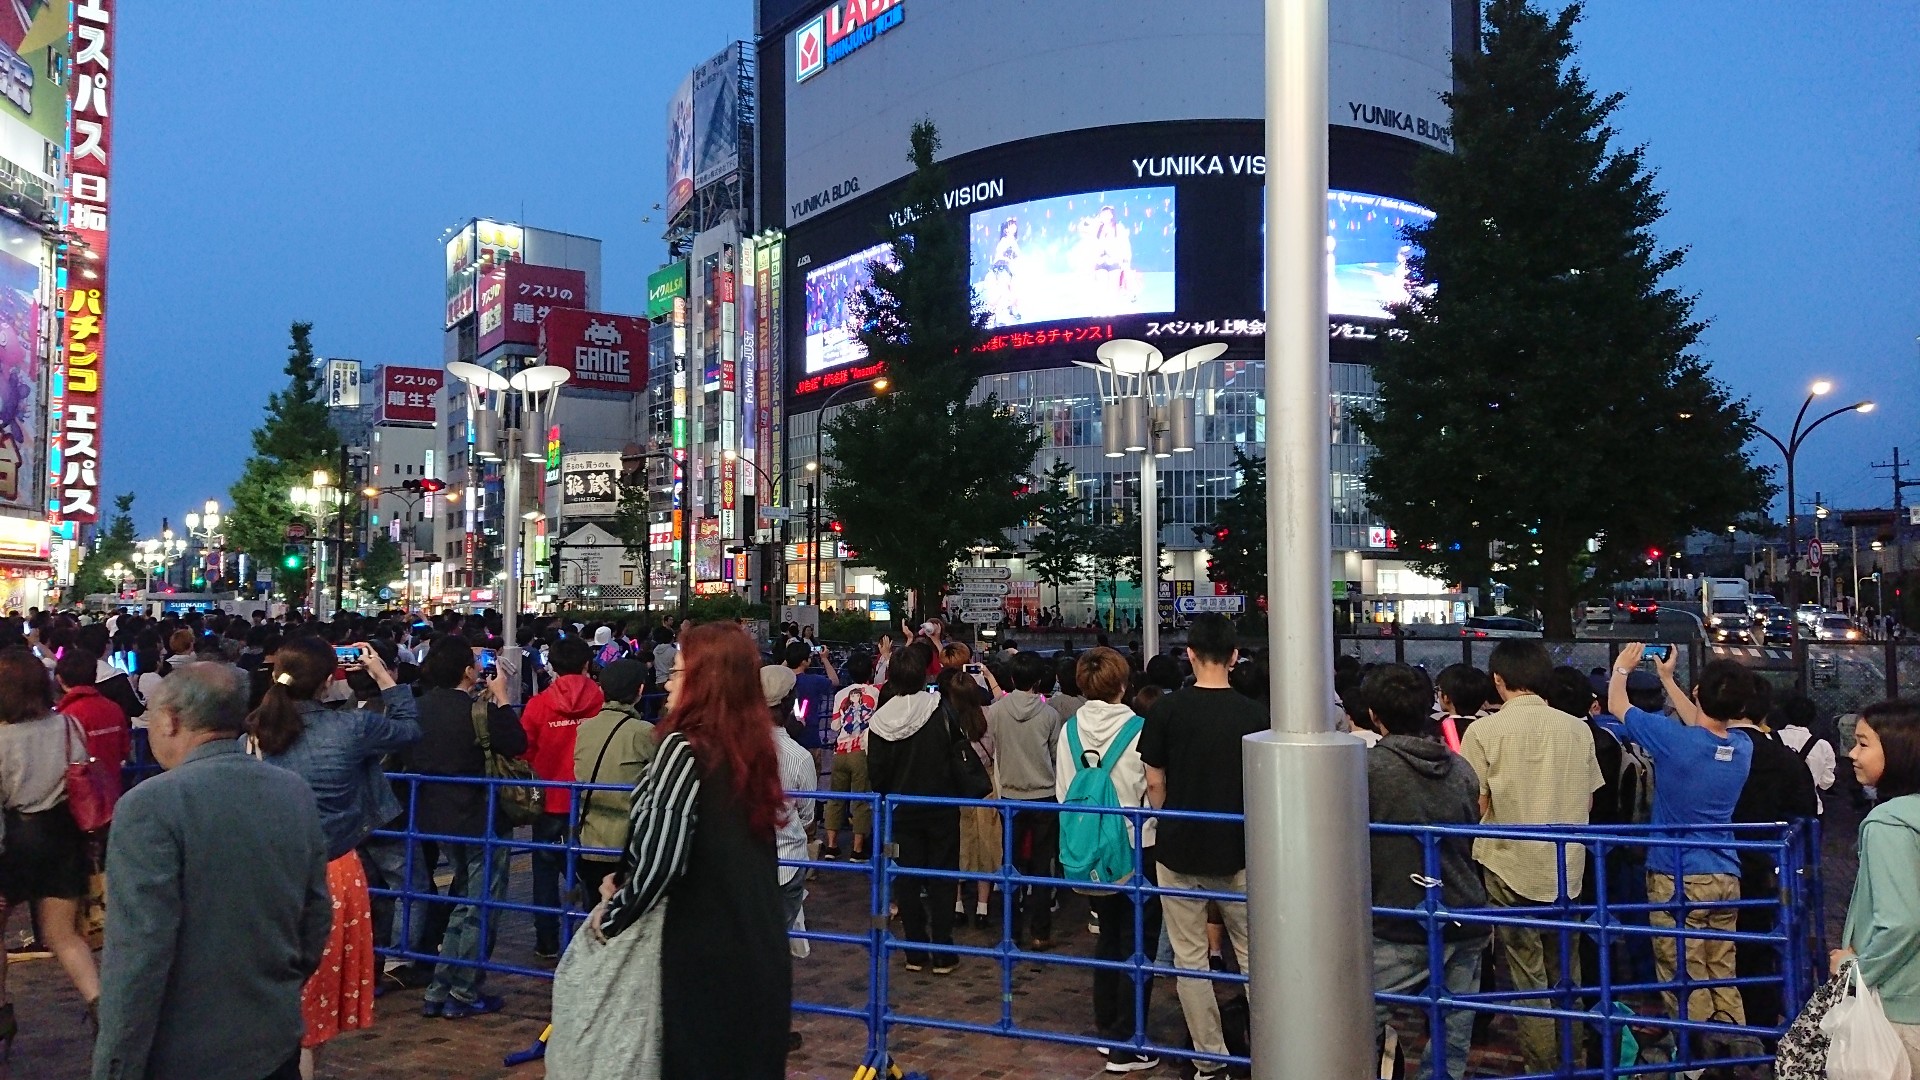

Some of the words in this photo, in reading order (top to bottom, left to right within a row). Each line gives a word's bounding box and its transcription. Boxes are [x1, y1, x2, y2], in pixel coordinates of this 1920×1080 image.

[825, 0, 900, 46] LAB
[826, 22, 875, 65] SHINJUKU
[1348, 101, 1415, 133] YUNIKA
[1132, 154, 1223, 177] YUNIKA
[791, 189, 831, 219] YUNIKA
[832, 176, 860, 201] BLDG.
[889, 198, 939, 229] YUN
[943, 178, 1004, 210] VISION
[519, 282, 573, 301] クスリの
[68, 289, 102, 393] パチンコ
[575, 345, 631, 374] GAME
[394, 374, 438, 386] クスリの
[576, 370, 598, 381] TAITO
[599, 371, 631, 384] STATION
[387, 389, 438, 408] 龍生堂
[62, 404, 98, 515] エスパス
[1200, 597, 1236, 607] 靖国通り
[548, 719, 575, 728] YUNIKA
